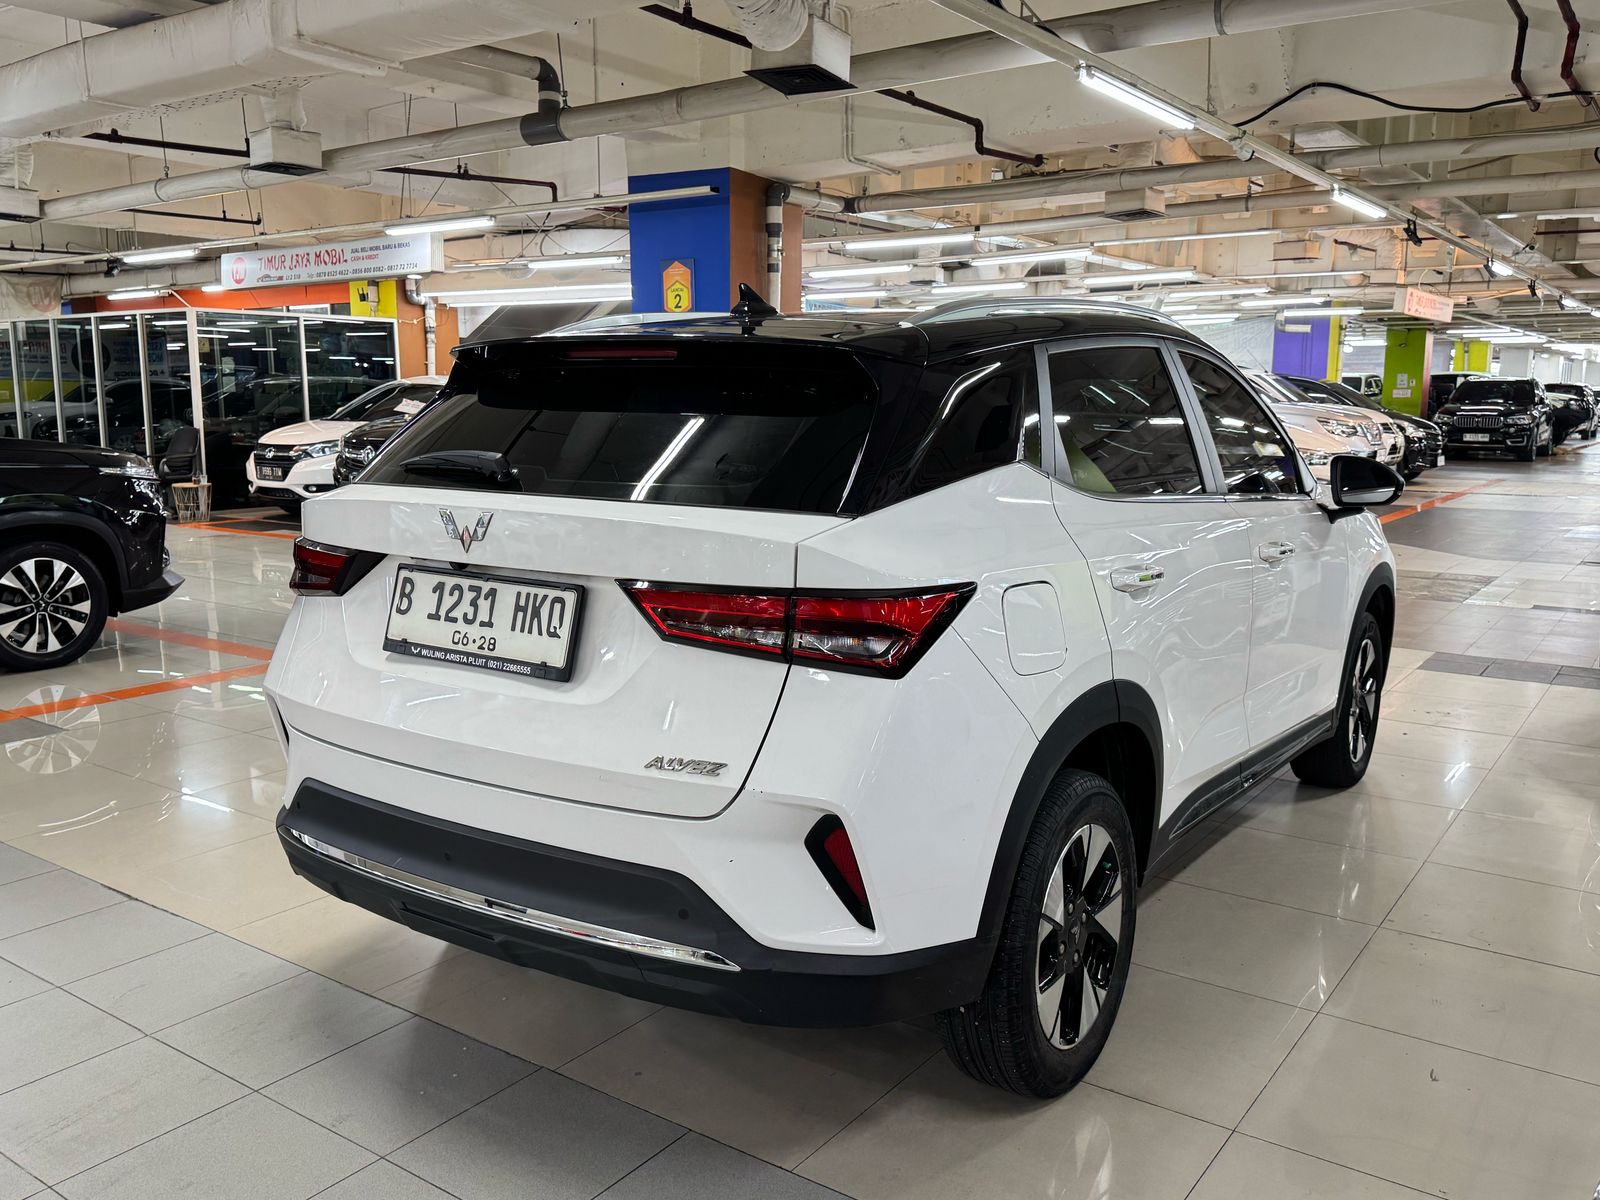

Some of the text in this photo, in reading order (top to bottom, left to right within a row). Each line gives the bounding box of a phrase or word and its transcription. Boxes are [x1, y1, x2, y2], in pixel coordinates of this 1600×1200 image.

[257, 254, 286, 271] TIMUR
[289, 252, 311, 270] JAYA
[314, 248, 348, 266] MOBIL
[674, 294, 682, 309] 2
[396, 576, 566, 639] B 1231 HKQ
[422, 648, 531, 674] WULING ARISTA PLUIT (021) 22665555
[644, 755, 728, 777] ALVEZ
